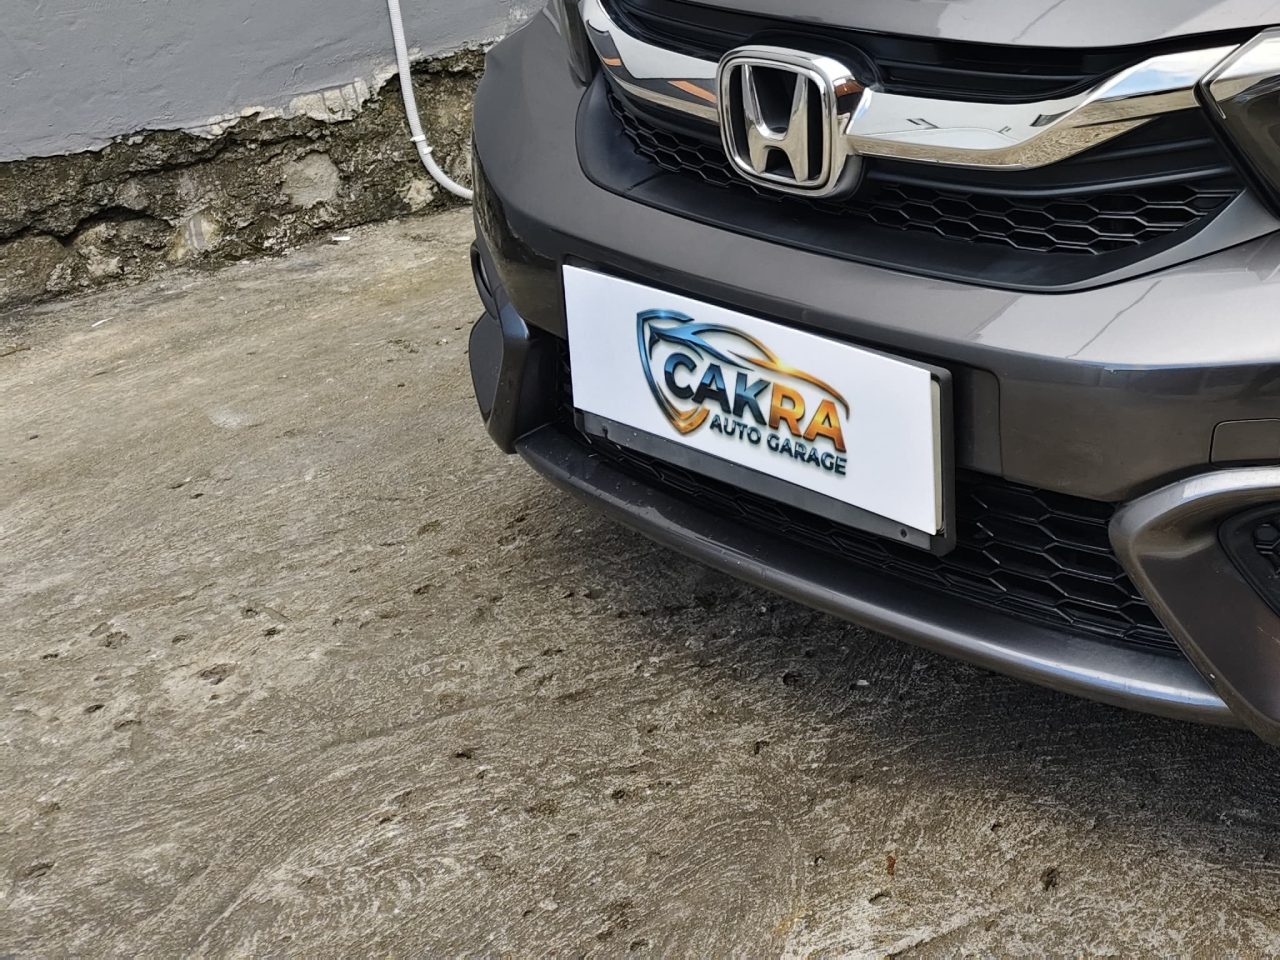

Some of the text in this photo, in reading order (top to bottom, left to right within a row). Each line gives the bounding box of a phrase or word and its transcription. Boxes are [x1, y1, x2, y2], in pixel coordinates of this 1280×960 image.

[663, 352, 847, 453] CAKRA
[709, 414, 848, 476] AUTO GARAGE
